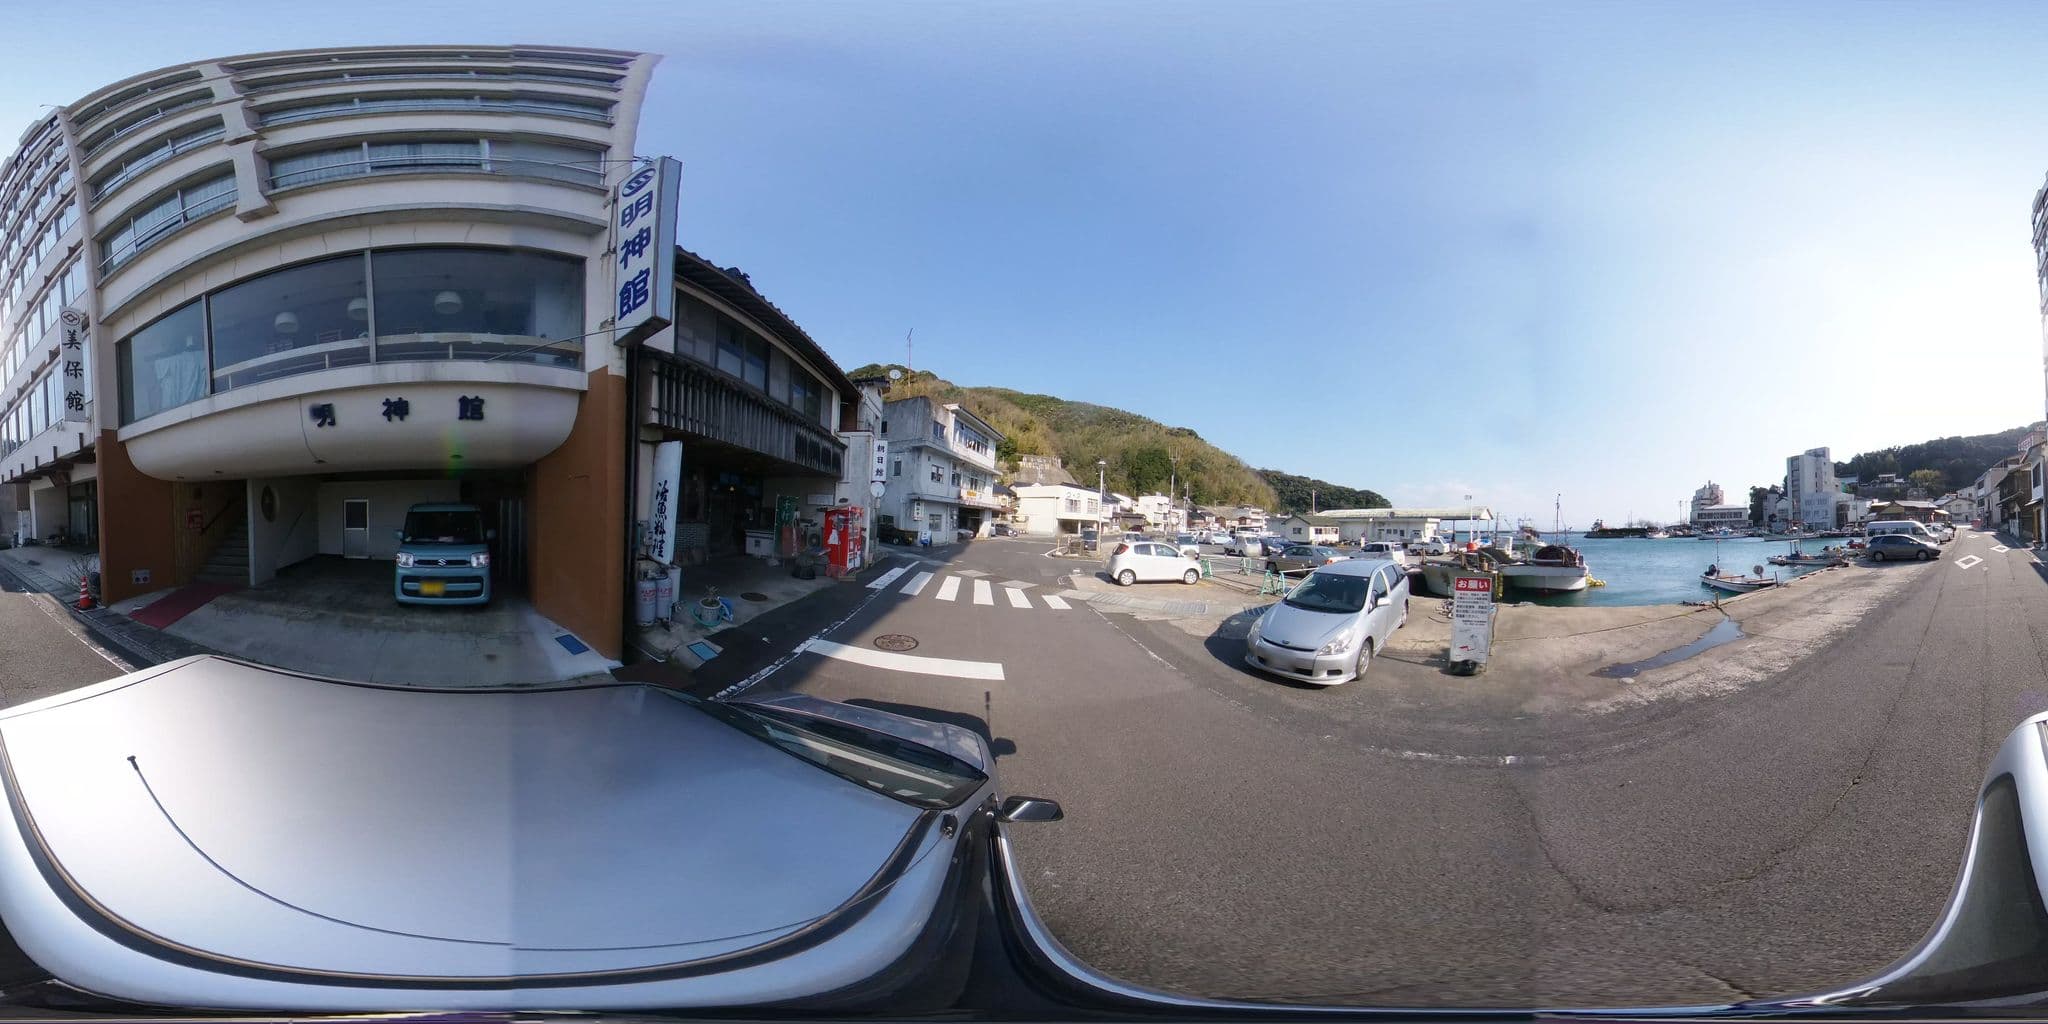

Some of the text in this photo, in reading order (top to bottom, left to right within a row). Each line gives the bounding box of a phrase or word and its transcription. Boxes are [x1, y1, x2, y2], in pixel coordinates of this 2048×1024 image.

[618, 190, 653, 321] 明神館
[63, 329, 84, 412] 美保館
[309, 396, 484, 427] 明神館
[1457, 580, 1488, 589] お願い
